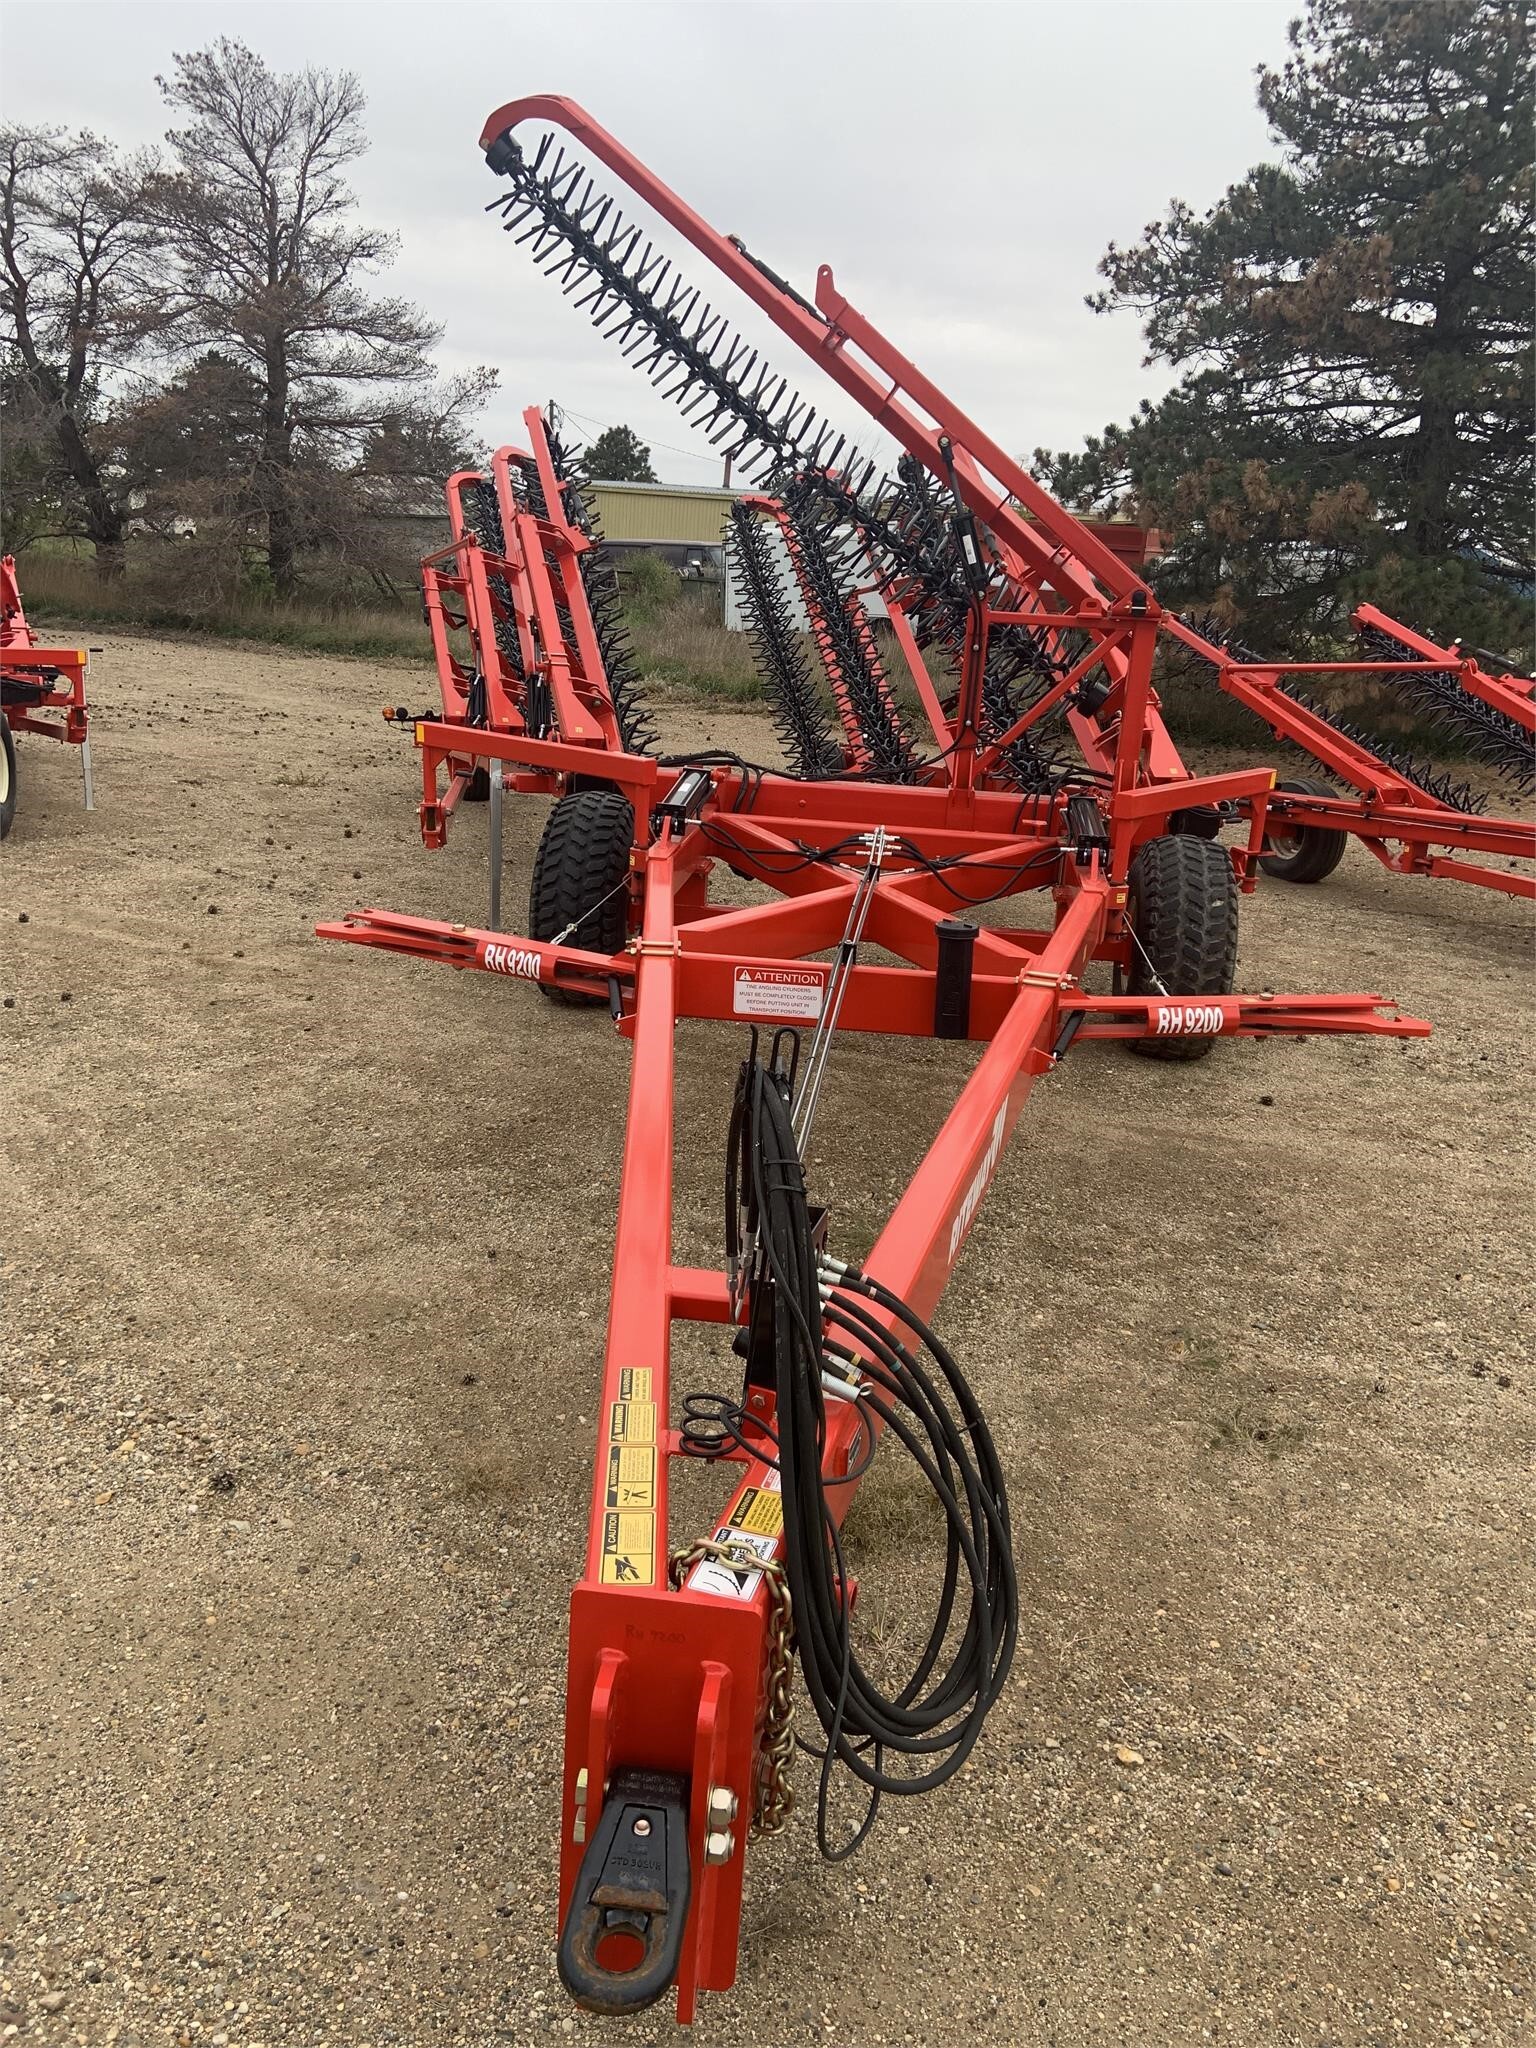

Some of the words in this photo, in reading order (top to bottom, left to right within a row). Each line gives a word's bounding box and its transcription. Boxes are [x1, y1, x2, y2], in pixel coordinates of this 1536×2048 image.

[485, 944, 507, 972] RH
[507, 949, 541, 979] 9200
[754, 971, 819, 984] ATTENTION
[1156, 1007, 1183, 1034] RH
[1184, 1006, 1224, 1034] 9200
[614, 1405, 624, 1433] WARNING
[610, 1459, 619, 1485] WARNING
[739, 1491, 755, 1517] WARNING
[607, 1514, 617, 1543] CAUTION
